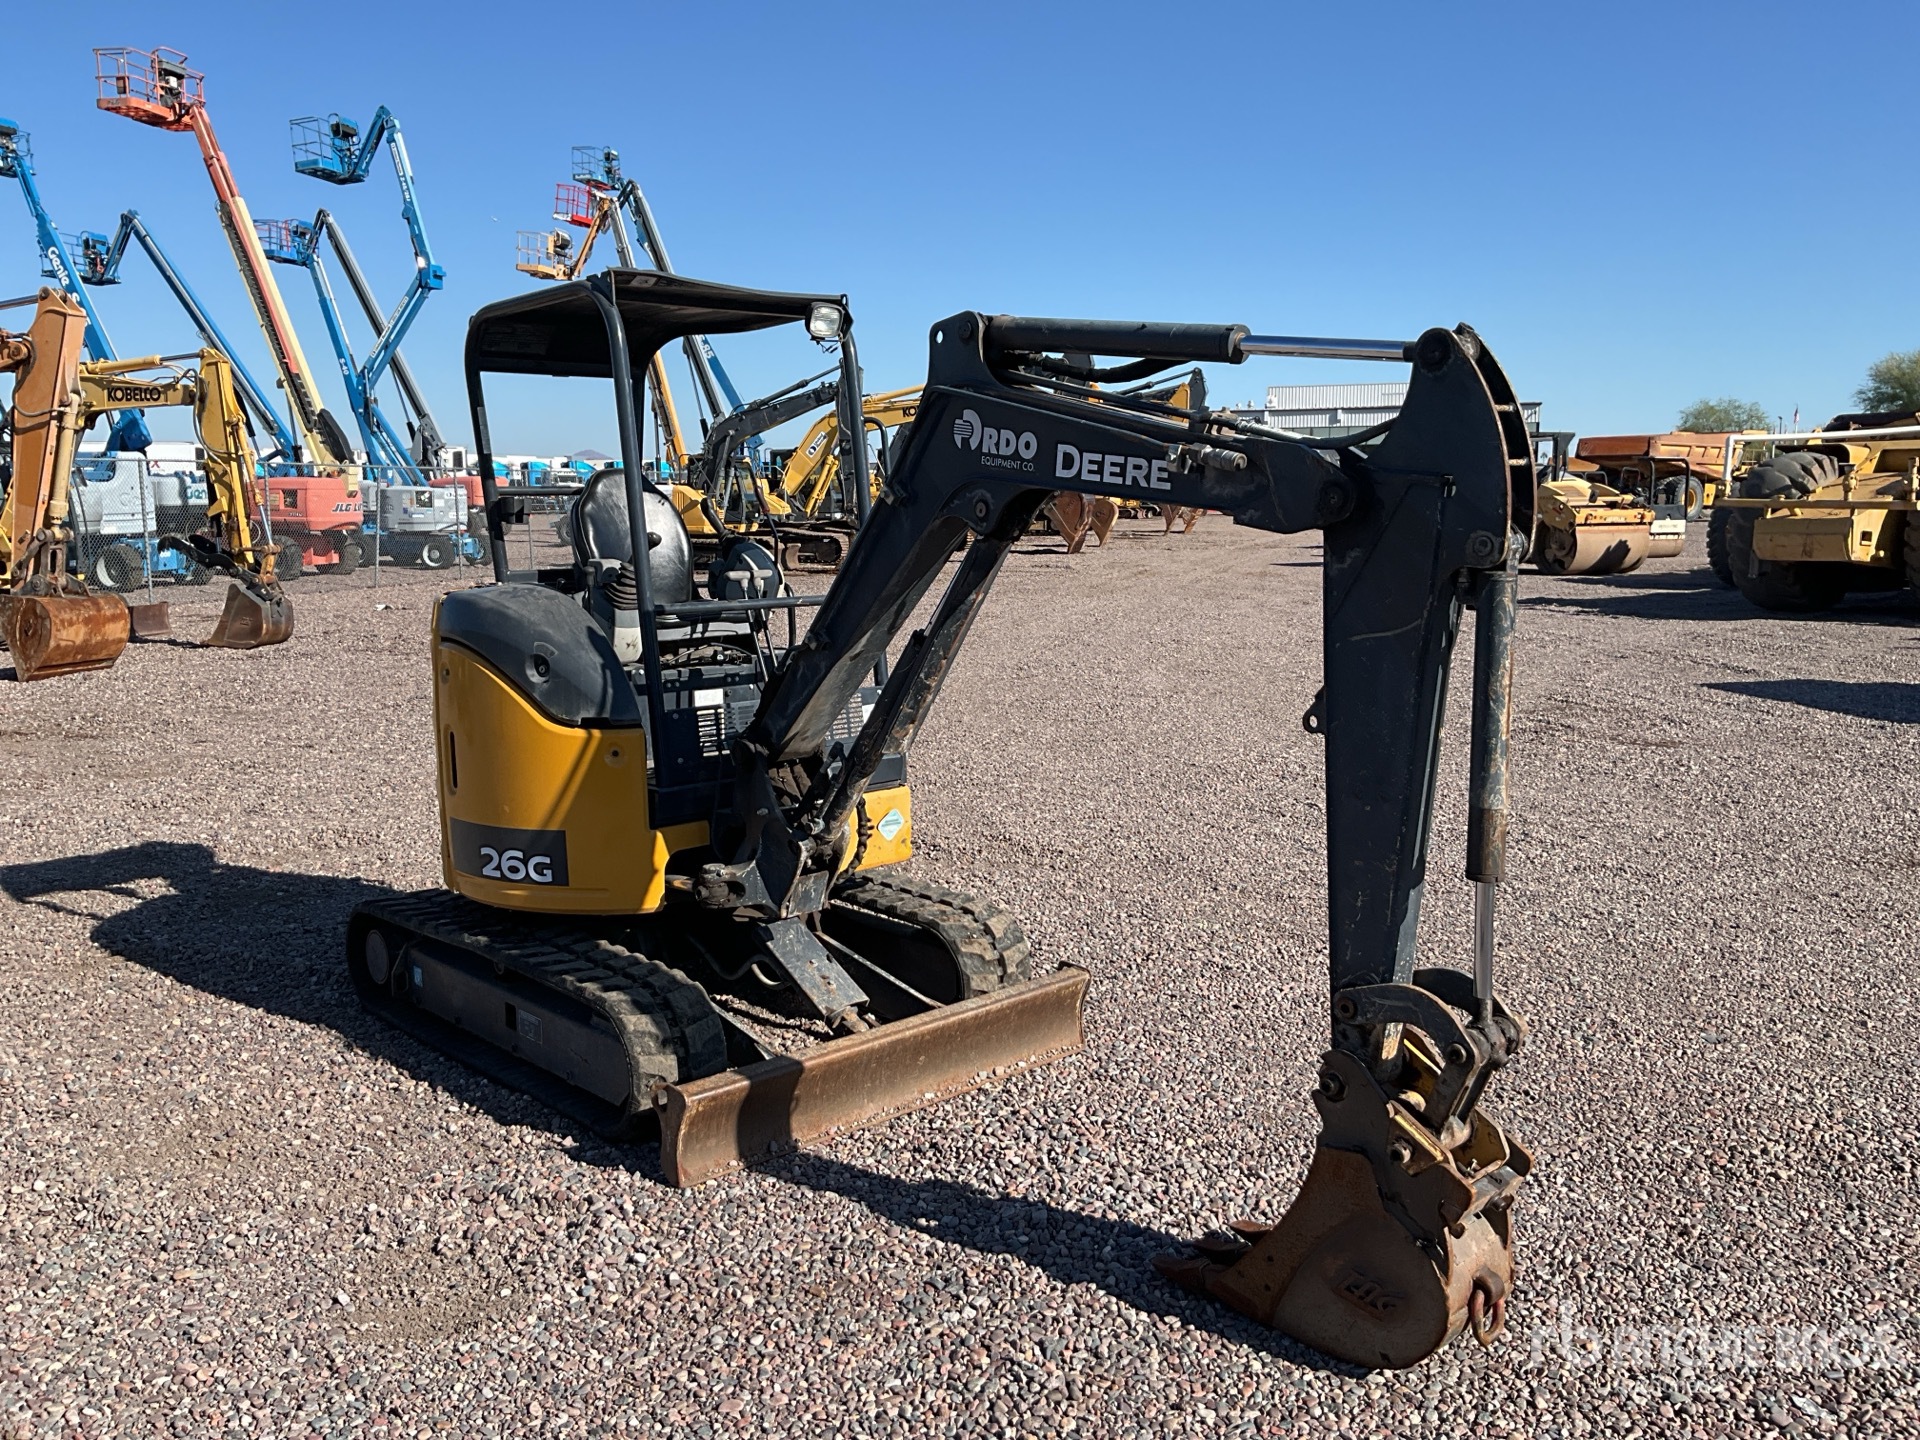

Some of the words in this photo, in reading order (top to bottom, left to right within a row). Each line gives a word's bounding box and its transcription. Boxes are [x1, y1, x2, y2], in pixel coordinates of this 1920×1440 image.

[47, 246, 70, 287] Genie
[338, 357, 350, 375] S-40
[107, 386, 161, 402] KOBELCO
[902, 405, 919, 418] KO
[981, 455, 1021, 470] EQUIPMENT
[1055, 443, 1171, 491] DEERE
[185, 486, 207, 499] Gen
[332, 503, 352, 512] JLG
[480, 846, 553, 883] 26G
